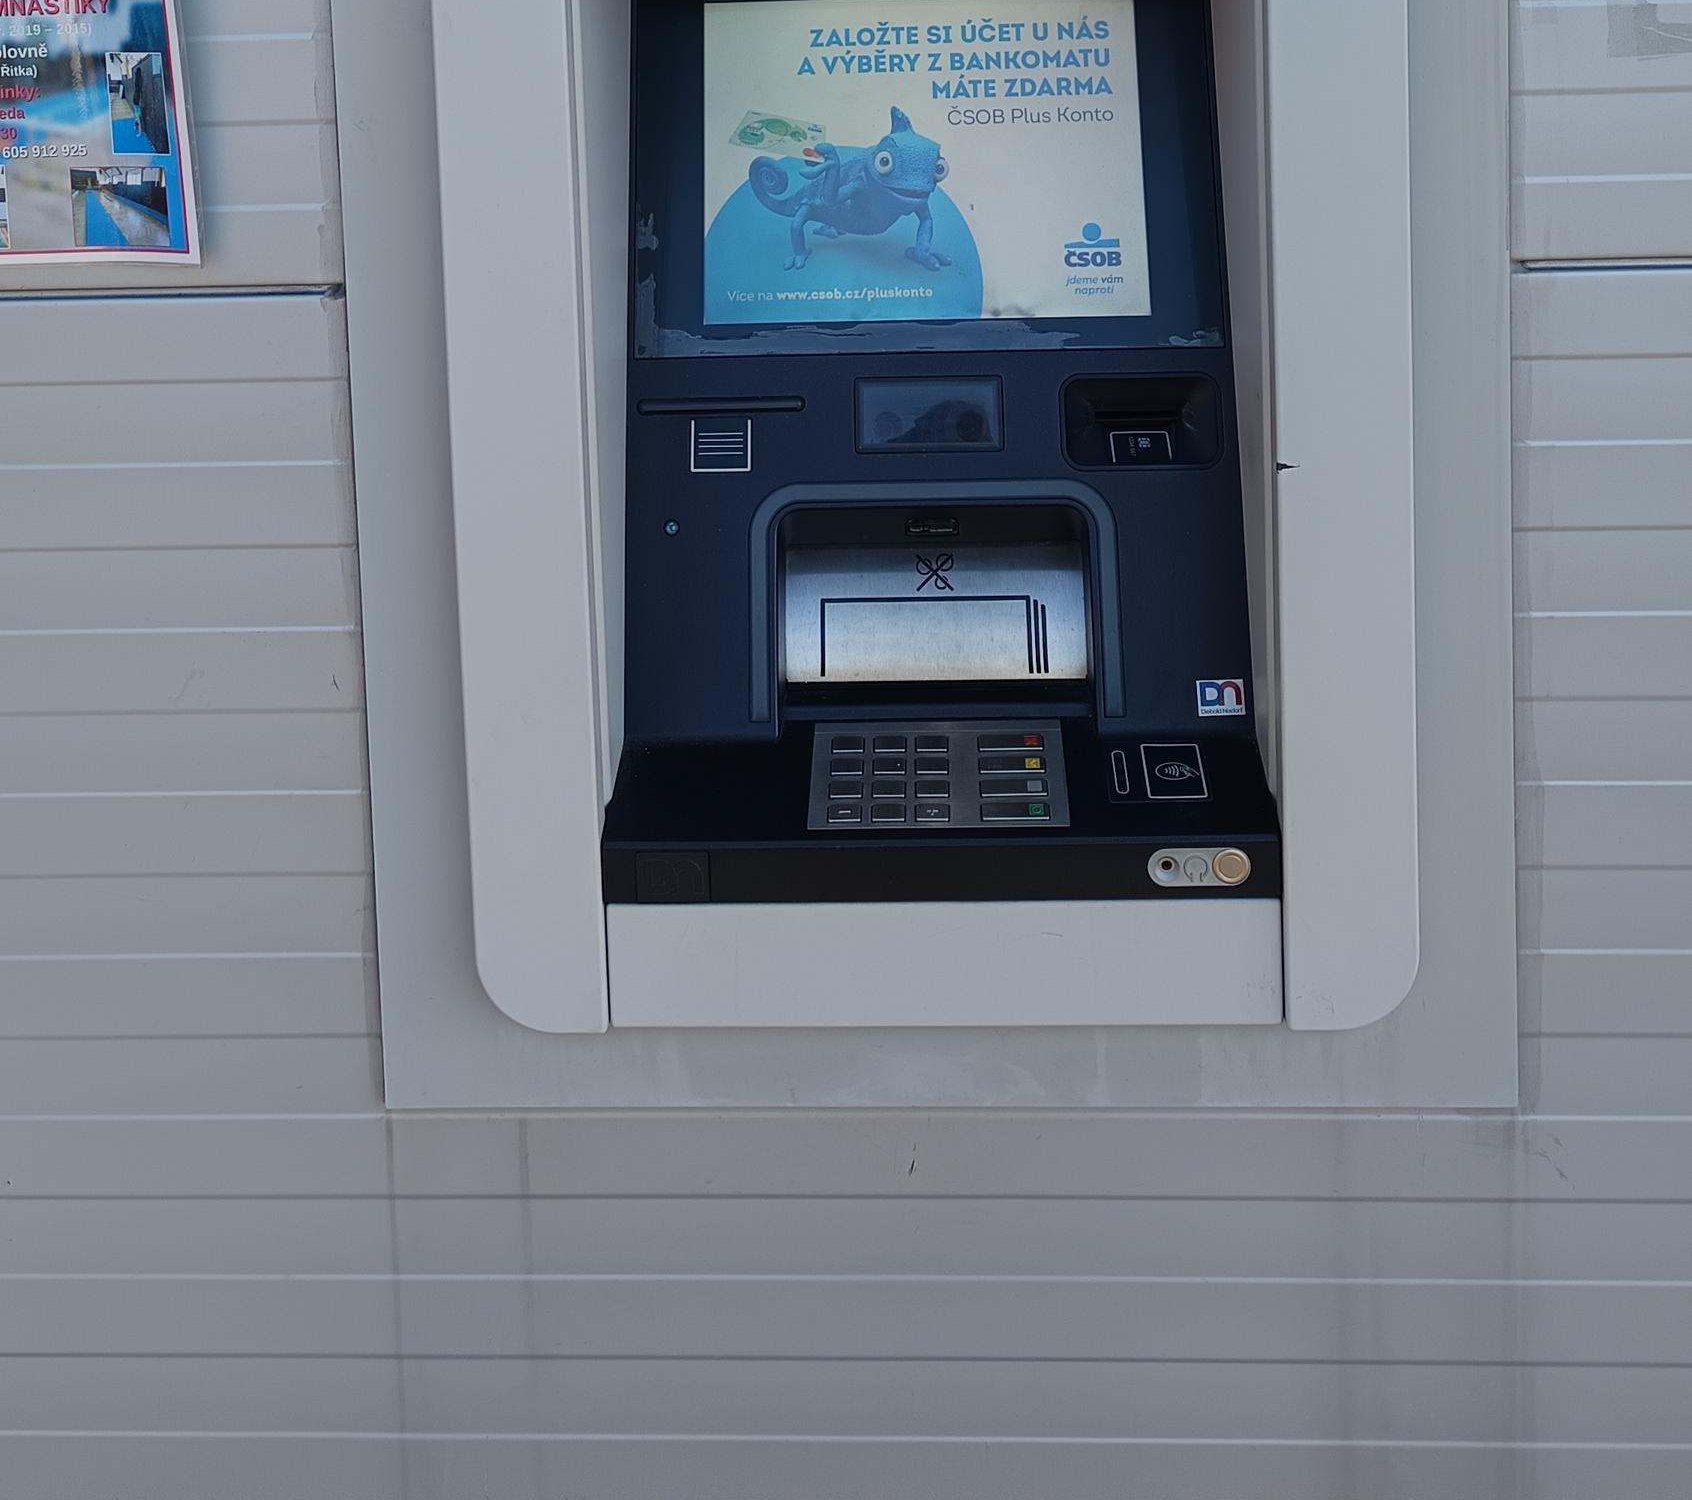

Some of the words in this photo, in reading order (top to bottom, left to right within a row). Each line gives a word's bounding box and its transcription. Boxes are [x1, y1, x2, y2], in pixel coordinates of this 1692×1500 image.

[9, 23, 41, 36] 2019
[56, 22, 92, 36] 2015)
[809, 21, 919, 47] ZALOŽTE
[926, 25, 952, 44] SI
[960, 18, 1025, 43] ÚČET
[1032, 22, 1049, 41] U
[1057, 15, 1110, 40] NÁS
[797, 56, 815, 75] A
[821, 50, 920, 75] VÝBĚRY
[927, 52, 943, 72] Z
[950, 48, 1110, 71] BANKOMATU
[1, 63, 38, 79] Řitka)
[931, 73, 997, 99] MÁTE
[1004, 75, 1113, 98] ZDARMA
[947, 105, 1005, 126] ČSOB
[1011, 107, 1051, 124] Plus
[1057, 106, 1114, 123] Konto
[2, 145, 29, 159] 605
[32, 144, 59, 158] 912
[62, 143, 88, 157] 925
[1064, 249, 1122, 267] ČSOB
[1065, 275, 1099, 286] jdeme
[1101, 274, 1124, 284] vám
[727, 290, 754, 301] Více
[758, 292, 773, 301] na
[776, 287, 933, 302] www.csob.cz/pluskonto
[1074, 285, 1114, 296] naproti
